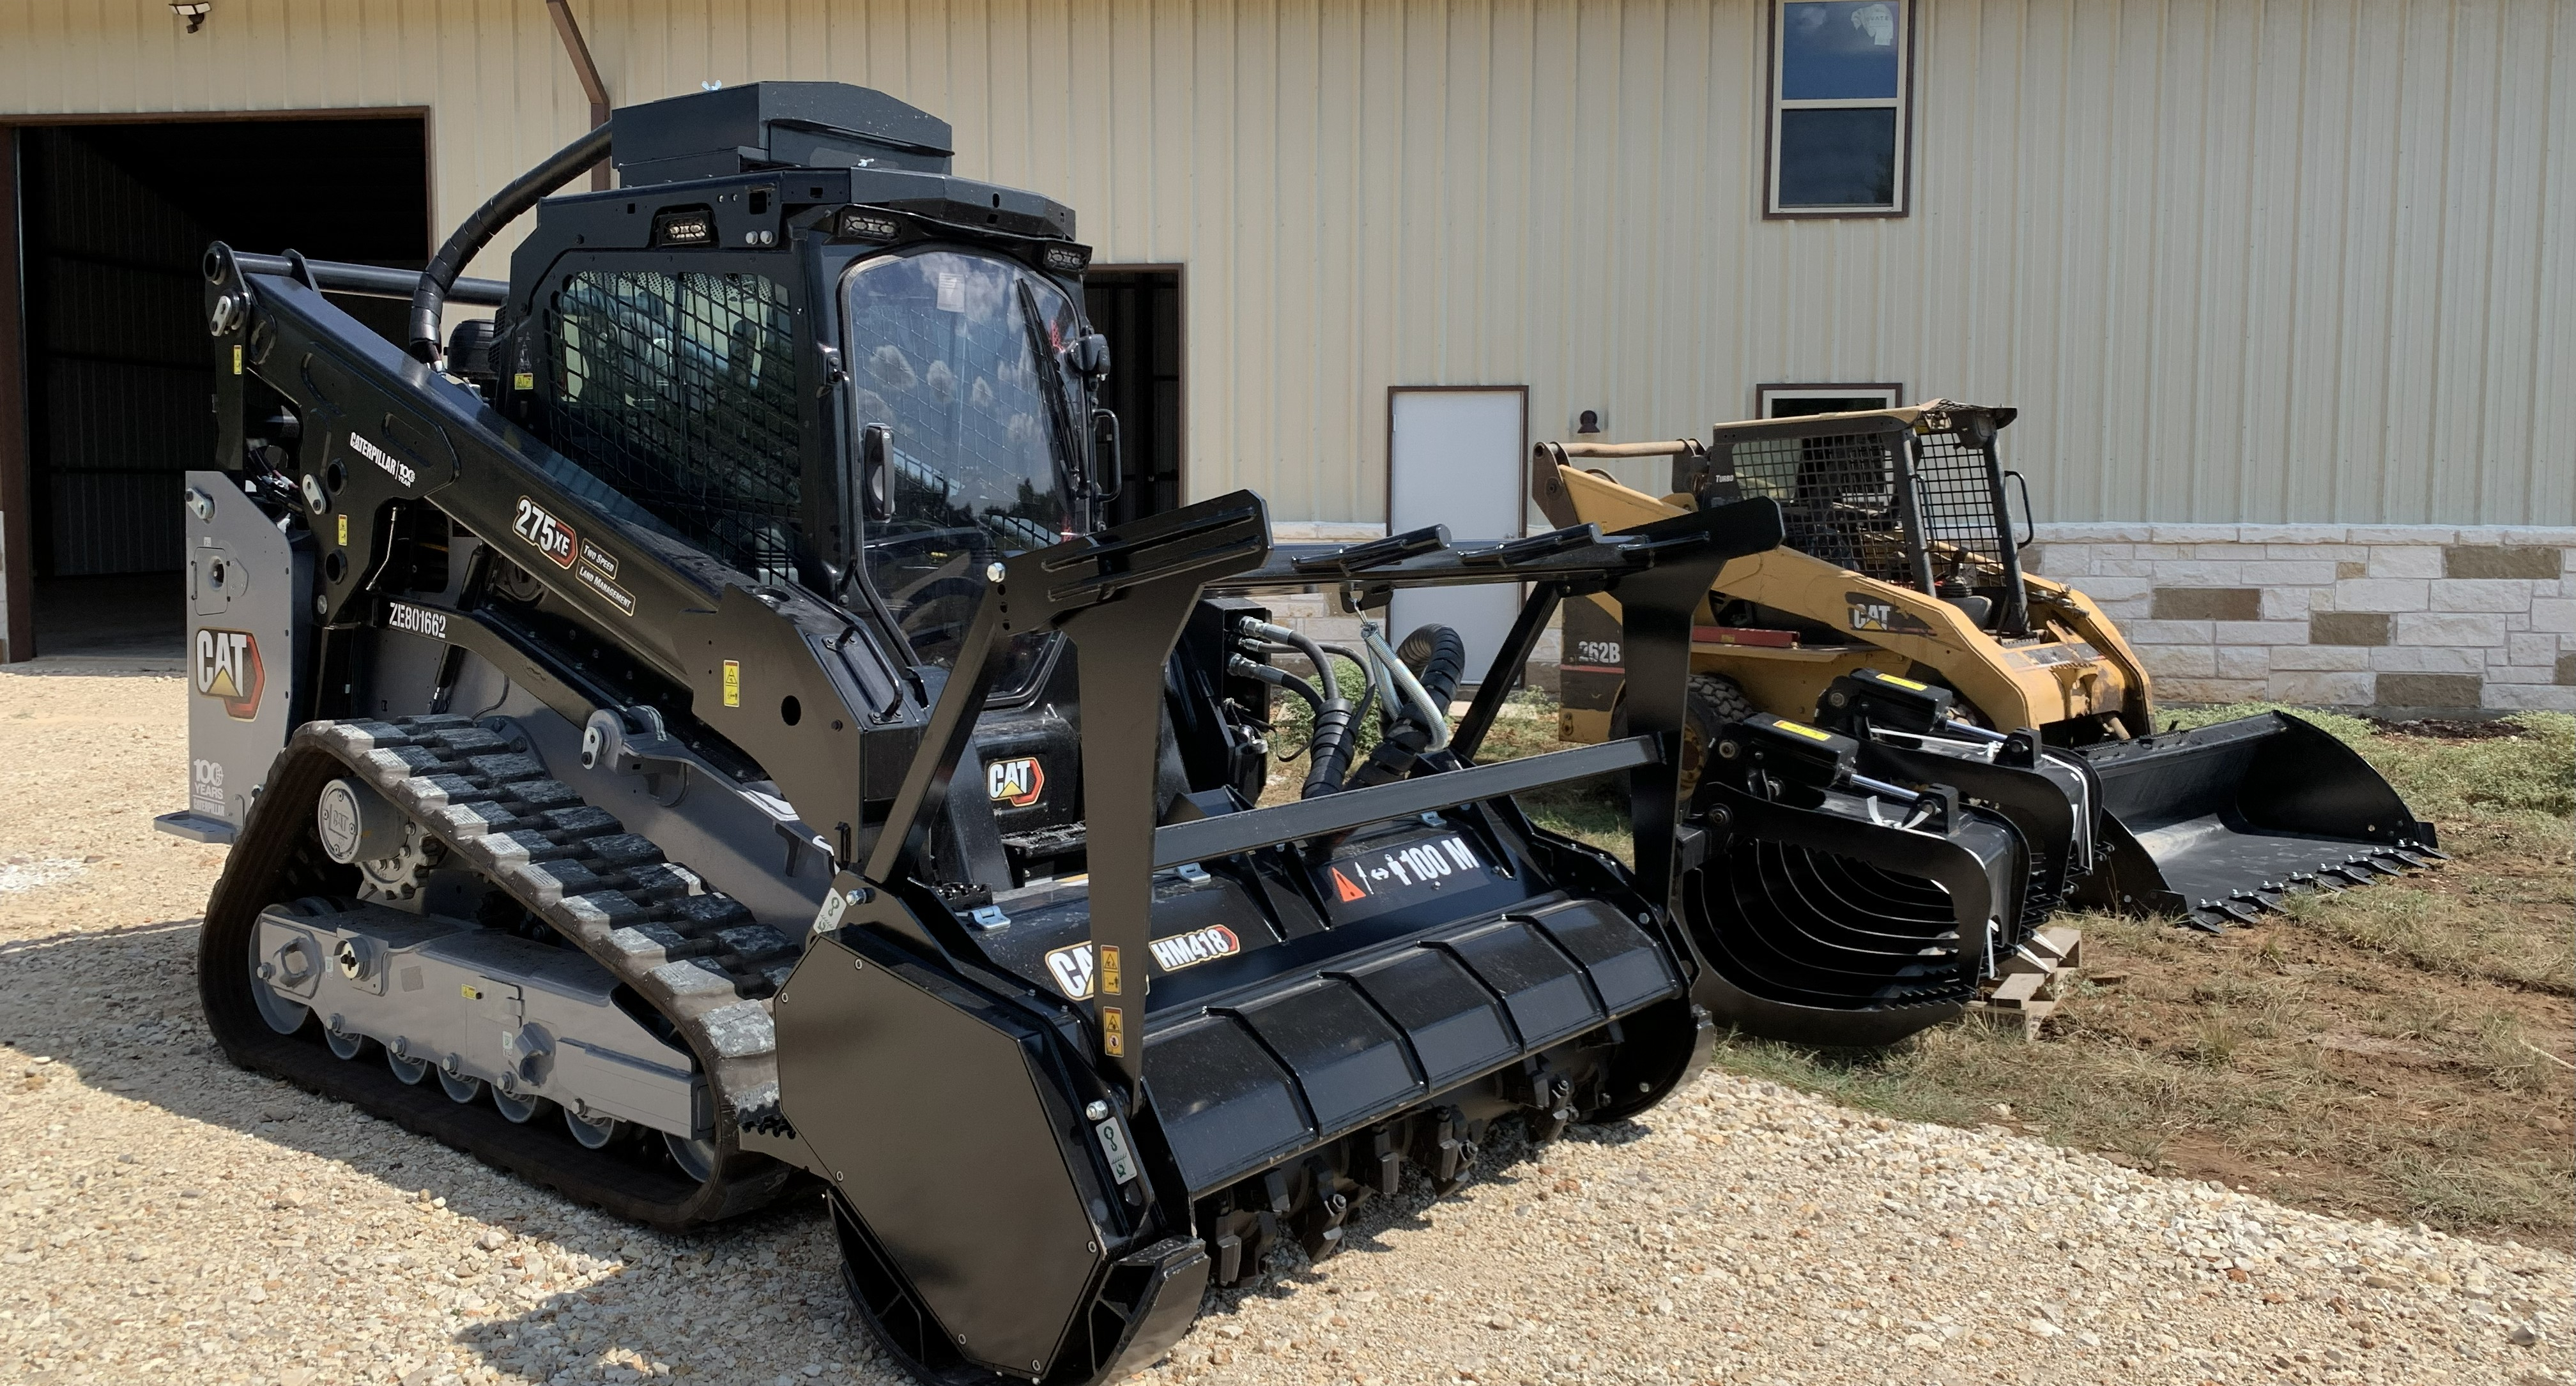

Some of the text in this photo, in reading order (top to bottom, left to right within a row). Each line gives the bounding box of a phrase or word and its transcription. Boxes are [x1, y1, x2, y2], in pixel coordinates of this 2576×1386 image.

[350, 432, 397, 476] CATERPILLAR
[1715, 475, 1734, 483] TURBO
[515, 499, 571, 557] 275XE
[583, 544, 615, 572] TWO SPEED
[579, 566, 632, 608] LAND MANAGEMENT
[389, 602, 446, 639] ZE801662
[1853, 603, 1891, 631] CAT
[196, 629, 247, 698] CAT
[1578, 641, 1621, 664] 262B
[194, 758, 224, 787] 100
[194, 782, 224, 800] YEARS
[989, 759, 1031, 798] CAT
[193, 798, 225, 817] CATERPILLAR
[1399, 837, 1481, 881] 100 M
[1151, 929, 1229, 968] HM418
[1048, 944, 1093, 997] CA
